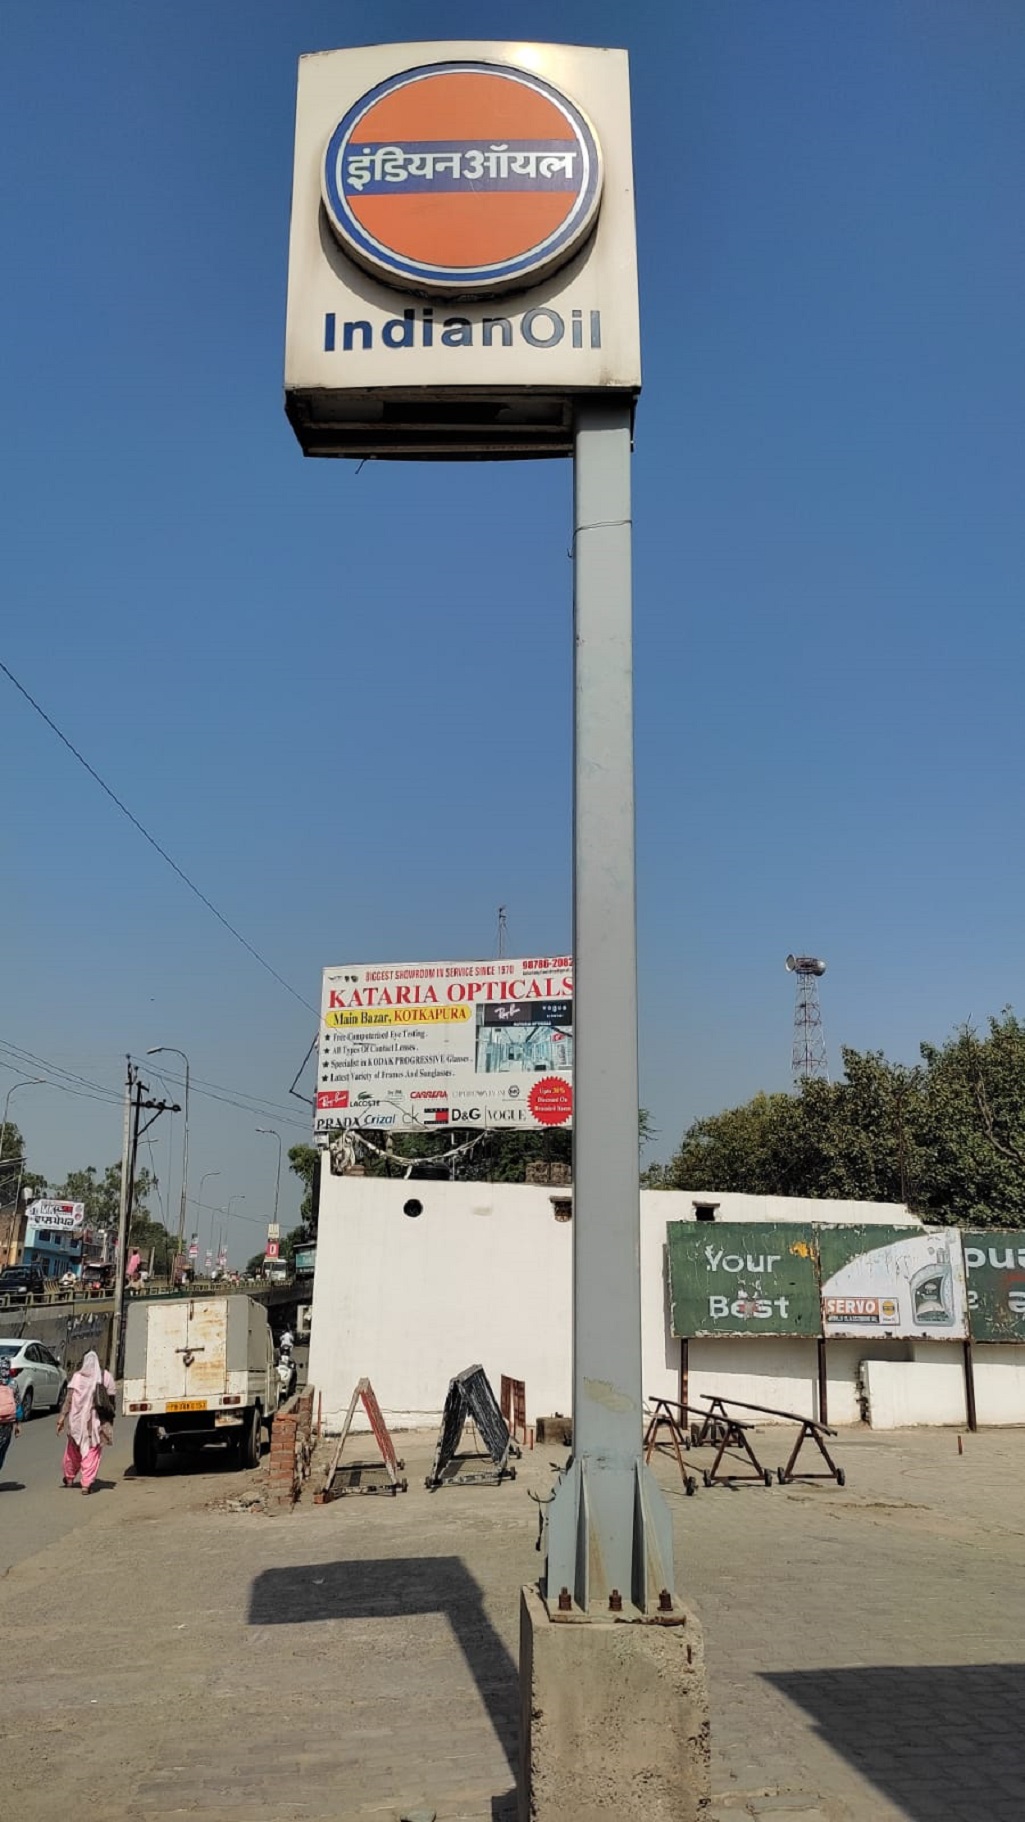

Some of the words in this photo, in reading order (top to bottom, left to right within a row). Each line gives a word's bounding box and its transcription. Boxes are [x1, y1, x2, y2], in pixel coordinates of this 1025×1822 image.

[347, 144, 577, 191] इंडियनऑयल
[324, 307, 602, 352] IndianOil
[365, 970, 394, 982] BIGGEST
[395, 968, 436, 980] SHOWROOM
[436, 967, 445, 978] IN
[445, 966, 474, 978] SERVICE
[475, 965, 496, 976] SINCE
[328, 984, 440, 1009] KATARIA
[446, 976, 573, 1002] OPTICALS
[333, 1011, 356, 1026] Main
[360, 1011, 392, 1025] Bazar,
[394, 1008, 467, 1022] KOTKAPURA
[410, 1090, 448, 1099] CARRERA
[349, 1099, 381, 1108] LACOSTE
[364, 1113, 396, 1125] Crizal
[451, 1107, 482, 1122] D&G
[488, 1108, 527, 1122] VOGUE
[316, 1116, 361, 1130] PRADA
[705, 1249, 781, 1273] Your
[709, 1295, 789, 1320] Best
[827, 1299, 876, 1314] SERVO
